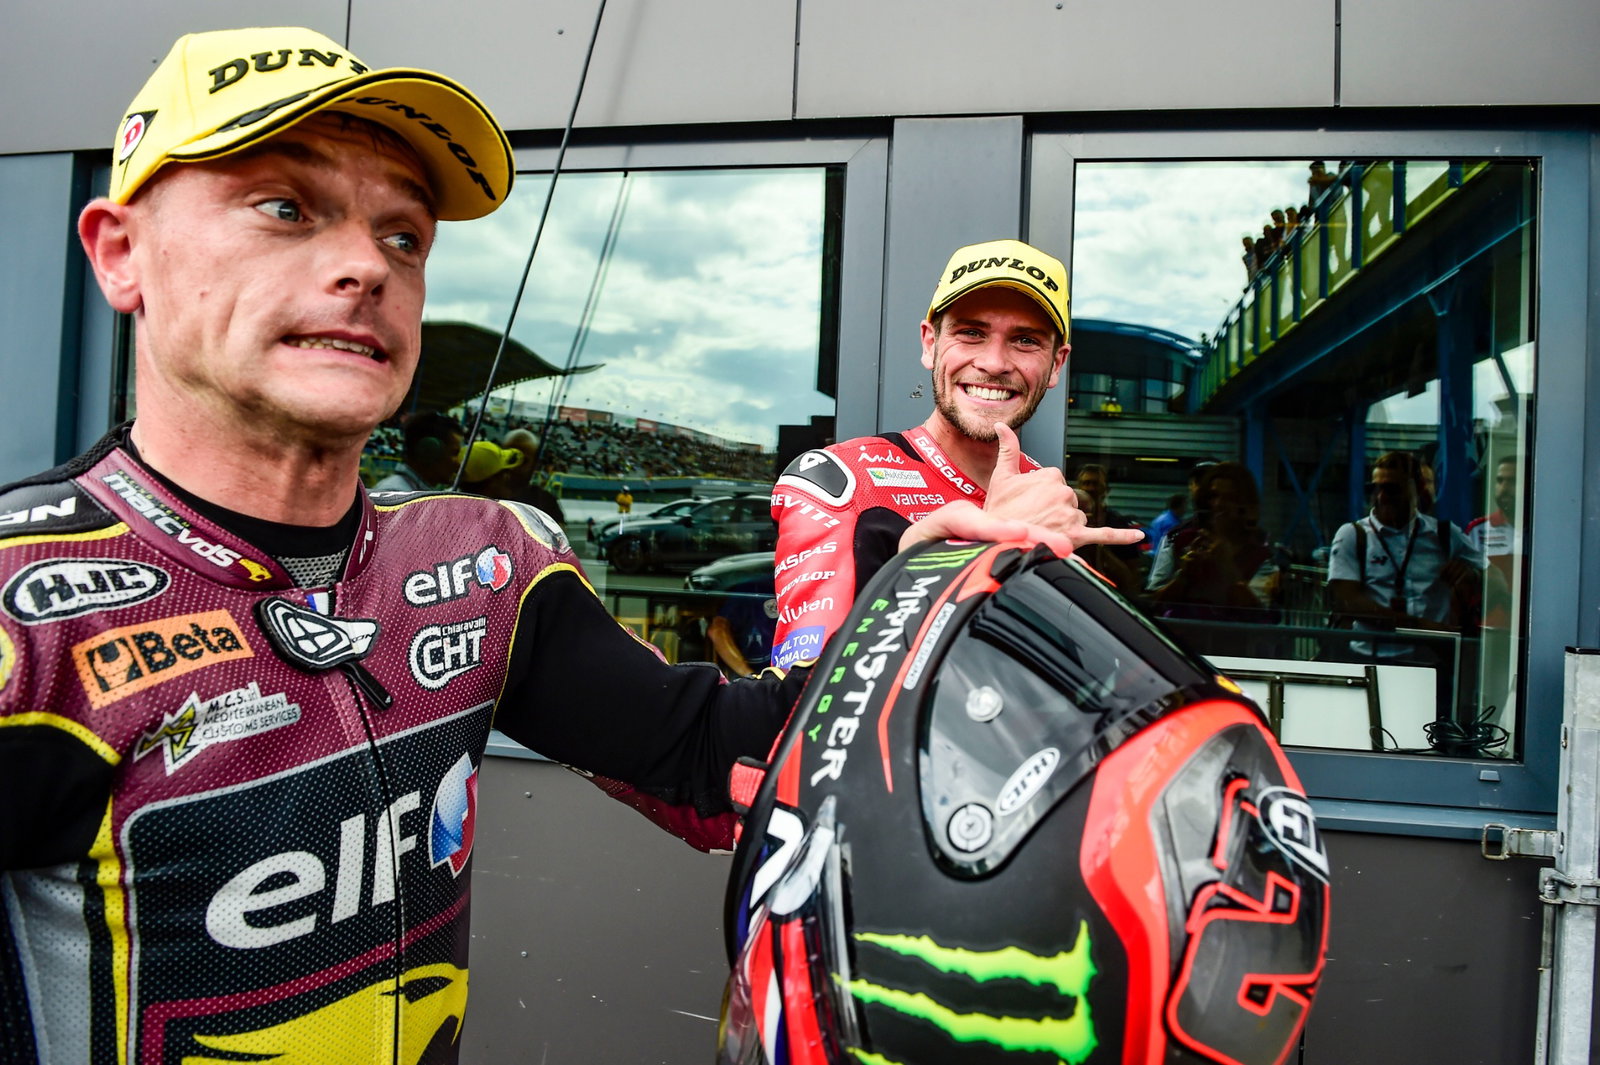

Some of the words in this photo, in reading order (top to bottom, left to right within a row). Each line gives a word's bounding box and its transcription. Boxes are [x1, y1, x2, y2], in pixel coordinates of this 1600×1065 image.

[949, 257, 1059, 292] DUNLOP
[914, 436, 976, 495] GASGAS
[891, 493, 946, 506] valresa
[26, 566, 147, 614] HJC
[404, 557, 474, 606] elf
[780, 570, 836, 597] DUNLOP
[130, 622, 243, 674] Beta
[441, 617, 487, 636] Chiaravalli
[423, 629, 487, 675] CHT
[807, 598, 890, 743] ENERGY
[206, 692, 247, 714] M.C.S.
[810, 575, 942, 788] MONSTER
[260, 707, 298, 729] SERVICES
[205, 790, 421, 950] elf
